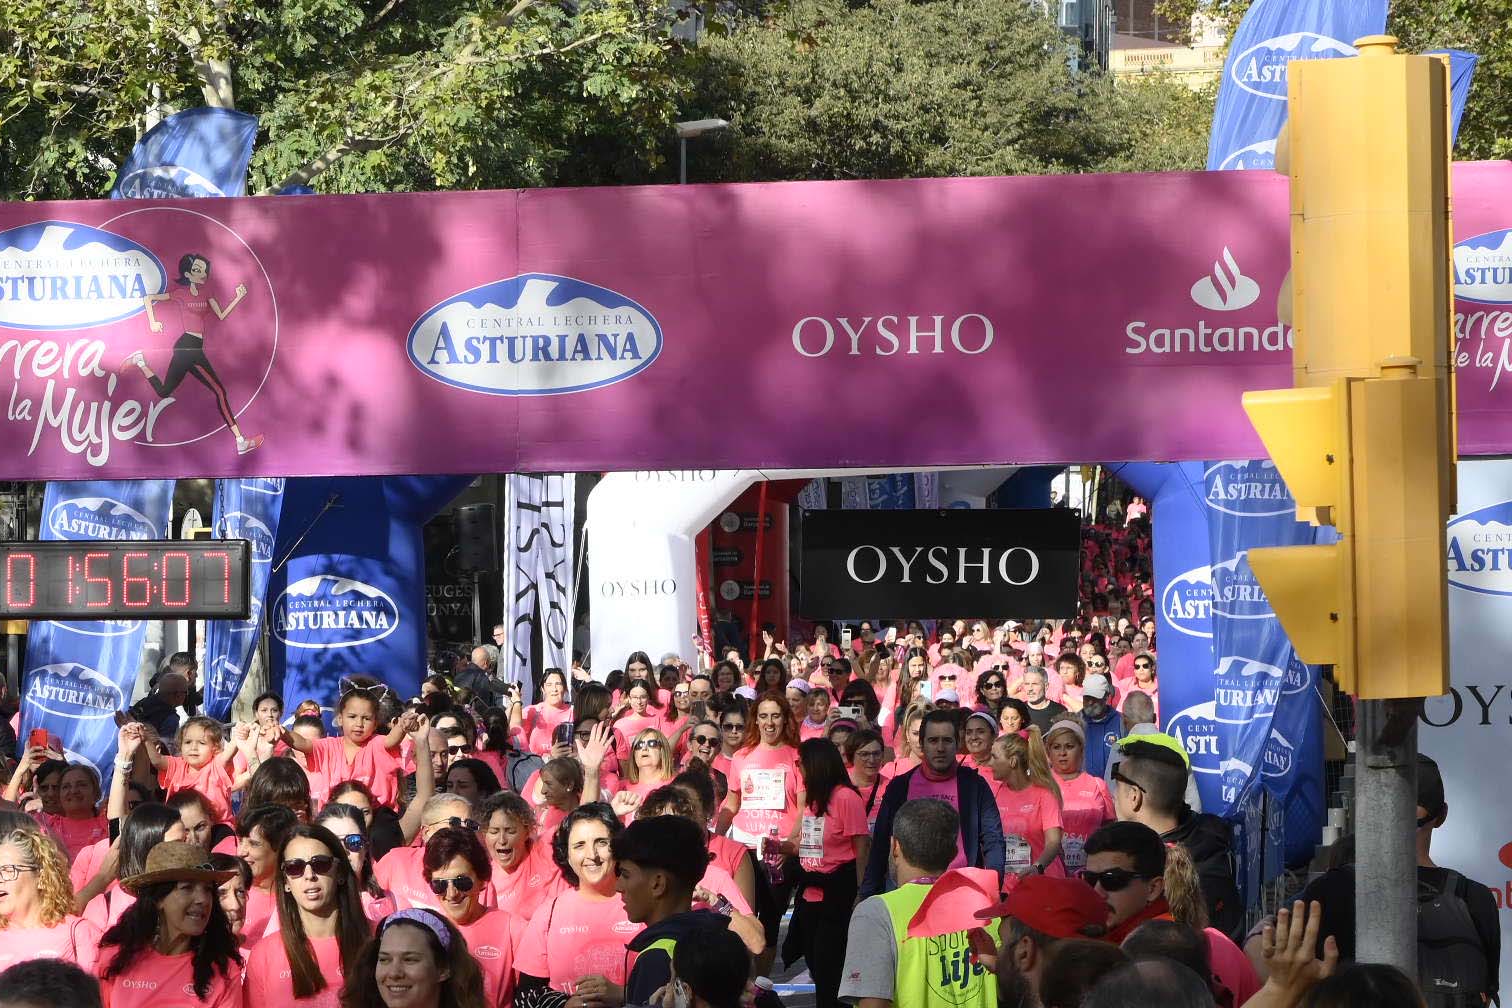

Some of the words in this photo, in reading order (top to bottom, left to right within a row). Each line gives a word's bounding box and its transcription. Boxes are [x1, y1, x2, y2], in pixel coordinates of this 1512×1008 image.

[466, 316, 546, 329] CENTRAL
[553, 314, 635, 326] LECHERA
[792, 313, 995, 357] OYSHO
[427, 321, 643, 365] ASTURIANA
[8, 381, 33, 421] la
[28, 373, 178, 467] Mujer
[6, 552, 231, 608] 01:56:07
[846, 544, 1041, 587] OYSHO
[289, 600, 332, 609] CENTRAL
[335, 599, 385, 608] LECHERA
[601, 578, 677, 600] OYSHO
[277, 604, 390, 632] ASTURIANA
[27, 675, 115, 712] ASTURIANA
[123, 980, 157, 991] OYSHO
